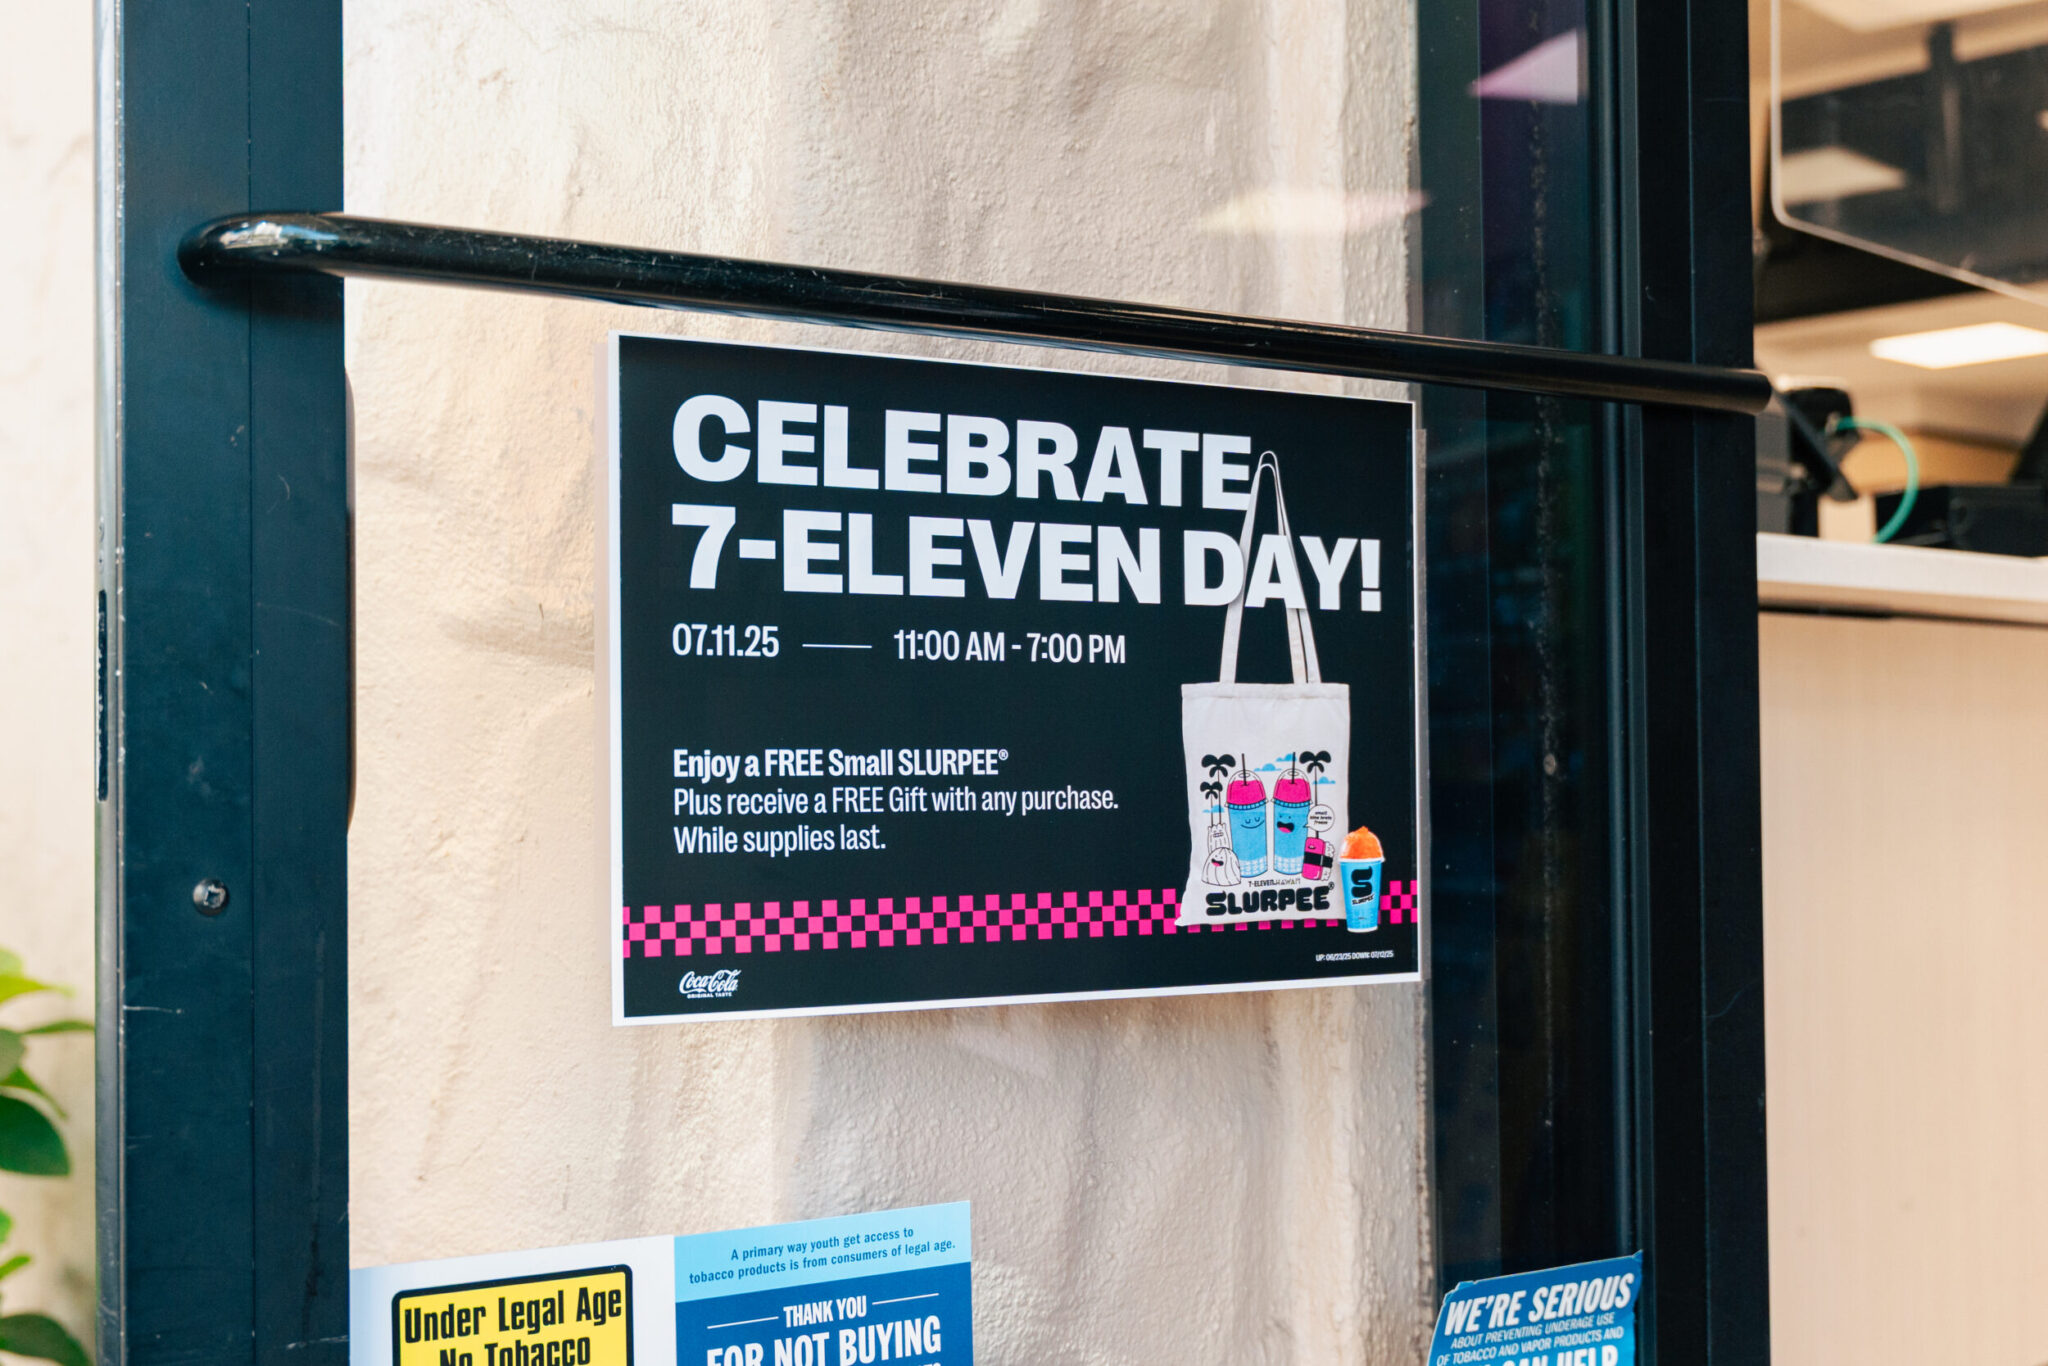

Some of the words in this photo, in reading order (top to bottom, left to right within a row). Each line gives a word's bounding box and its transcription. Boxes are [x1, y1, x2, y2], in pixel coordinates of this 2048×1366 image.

[672, 394, 1252, 511] CELEBRATE
[672, 503, 1161, 605] 7-ELEVEN
[1183, 529, 1382, 612] DAY!
[672, 623, 780, 658] 07.11.25
[893, 628, 960, 661] 11:00
[965, 630, 1005, 662] AM
[1026, 632, 1082, 664] 7:00
[1088, 634, 1126, 664] PM
[673, 748, 741, 784] Enjoy
[744, 754, 761, 777] a
[764, 748, 824, 777] FREE
[828, 748, 894, 776] Small
[674, 788, 722, 816] Plus
[727, 787, 809, 815] receive
[814, 792, 827, 814] a
[832, 786, 884, 813] FREE
[888, 786, 928, 812] Gift
[931, 786, 977, 812] with
[981, 789, 1017, 817] any
[1021, 785, 1119, 816] purchase.
[673, 826, 738, 854] While
[742, 824, 835, 858] supplies
[840, 823, 886, 850] last.
[679, 969, 742, 994] Coca-Cola
[689, 1268, 734, 1285] tobacco
[737, 1260, 787, 1280] products
[789, 1259, 800, 1271] is
[802, 1255, 828, 1269] from
[830, 1249, 888, 1266] consumers
[890, 1244, 902, 1257] of
[904, 1240, 931, 1257] legal
[934, 1239, 956, 1254] age.
[730, 1248, 739, 1261] A
[742, 1244, 784, 1262] primary
[787, 1241, 807, 1255] way
[810, 1236, 840, 1253] youth
[843, 1233, 861, 1249] get
[864, 1230, 900, 1244] access
[903, 1227, 914, 1239] to
[404, 1303, 487, 1344] Under
[498, 1289, 564, 1335] Legal
[576, 1286, 622, 1327] Age
[783, 1301, 834, 1328] THANK
[836, 1295, 867, 1319] YOU
[1444, 1290, 1527, 1336] WE'RE
[1528, 1272, 1635, 1323] SERIOUS
[773, 1331, 830, 1366] NOT
[838, 1315, 941, 1366] BUYING
[1436, 1354, 1450, 1366] OF
[1452, 1346, 1496, 1365] TOBACCO
[1498, 1341, 1518, 1357] AND
[1520, 1337, 1551, 1354] VAPOR
[1553, 1329, 1603, 1348] PRODUCTS
[1603, 1325, 1625, 1340] AND
[1451, 1333, 1483, 1350] ABOUT
[1485, 1324, 1543, 1344] PREVENTING
[1544, 1315, 1594, 1334] UNDERAGE
[1596, 1311, 1616, 1327] USE
[484, 1336, 591, 1366] Tobacco
